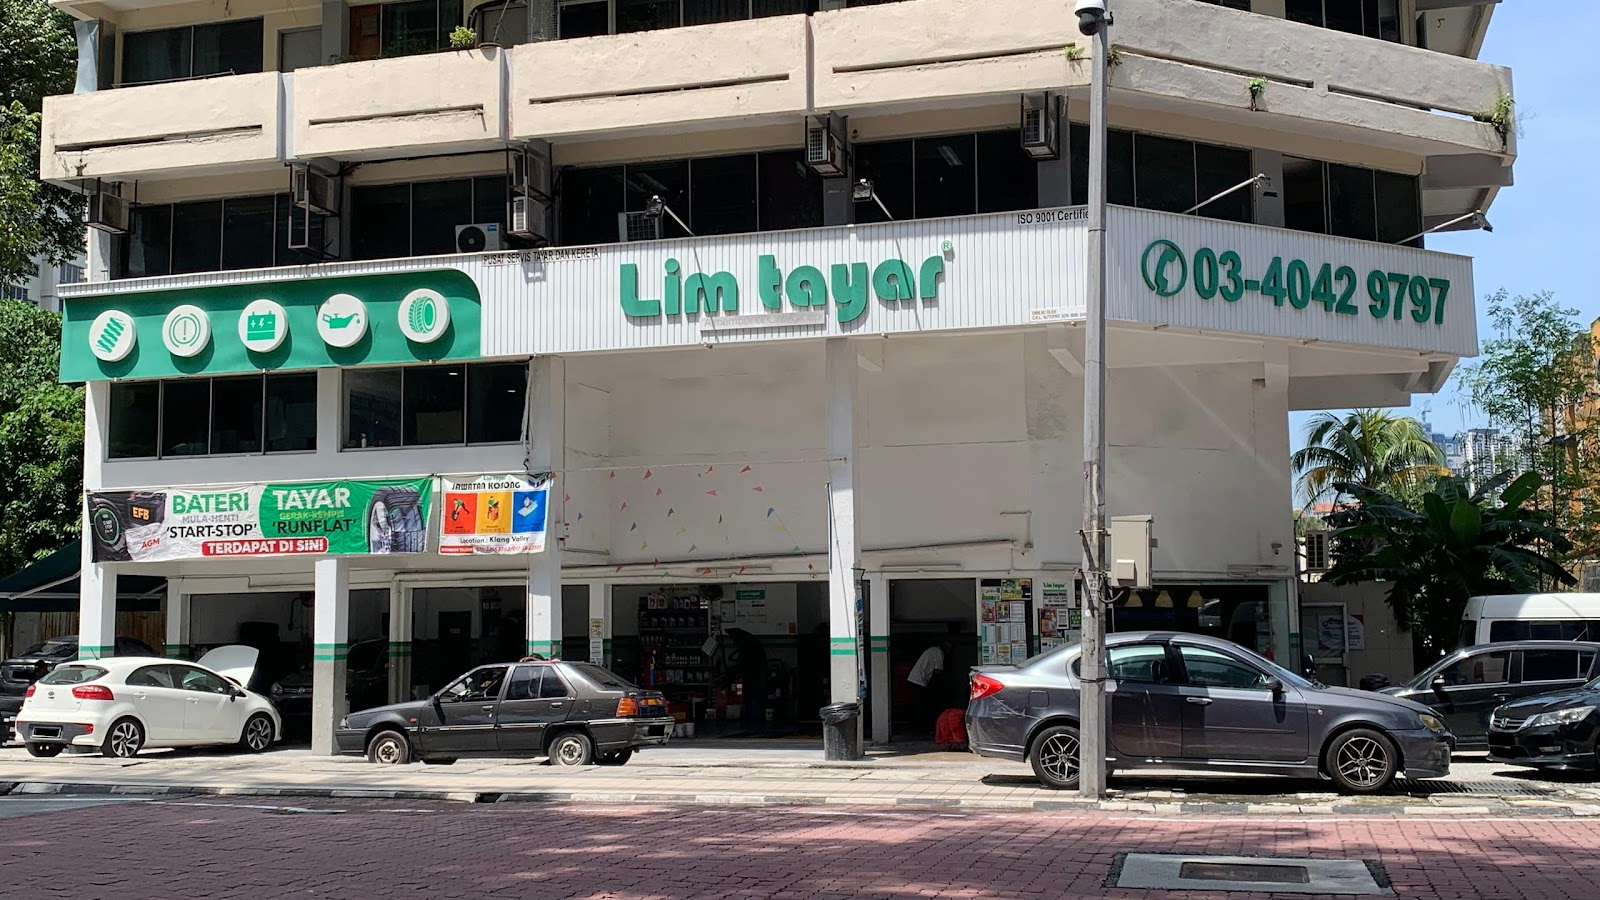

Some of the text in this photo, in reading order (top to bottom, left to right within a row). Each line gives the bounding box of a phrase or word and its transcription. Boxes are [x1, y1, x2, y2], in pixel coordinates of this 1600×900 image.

[1017, 208, 1089, 224] ISO 9001 Certifie
[483, 247, 598, 265] PUSAT SERVIS TAYAR DAN KERETA
[620, 257, 738, 317] Lim
[759, 254, 943, 323] tayar
[1193, 247, 1450, 325] 03-4042 9797
[451, 481, 521, 491] JAWATAN KOSONG
[172, 493, 249, 514] BATERI
[272, 487, 352, 510] TAYAR
[132, 506, 150, 520] EFB
[182, 514, 239, 524] MULA-HENTI
[141, 538, 160, 549] AGM
[207, 540, 276, 554] TERDAPAT
[279, 540, 294, 552] DI
[489, 536, 510, 544] Klang
